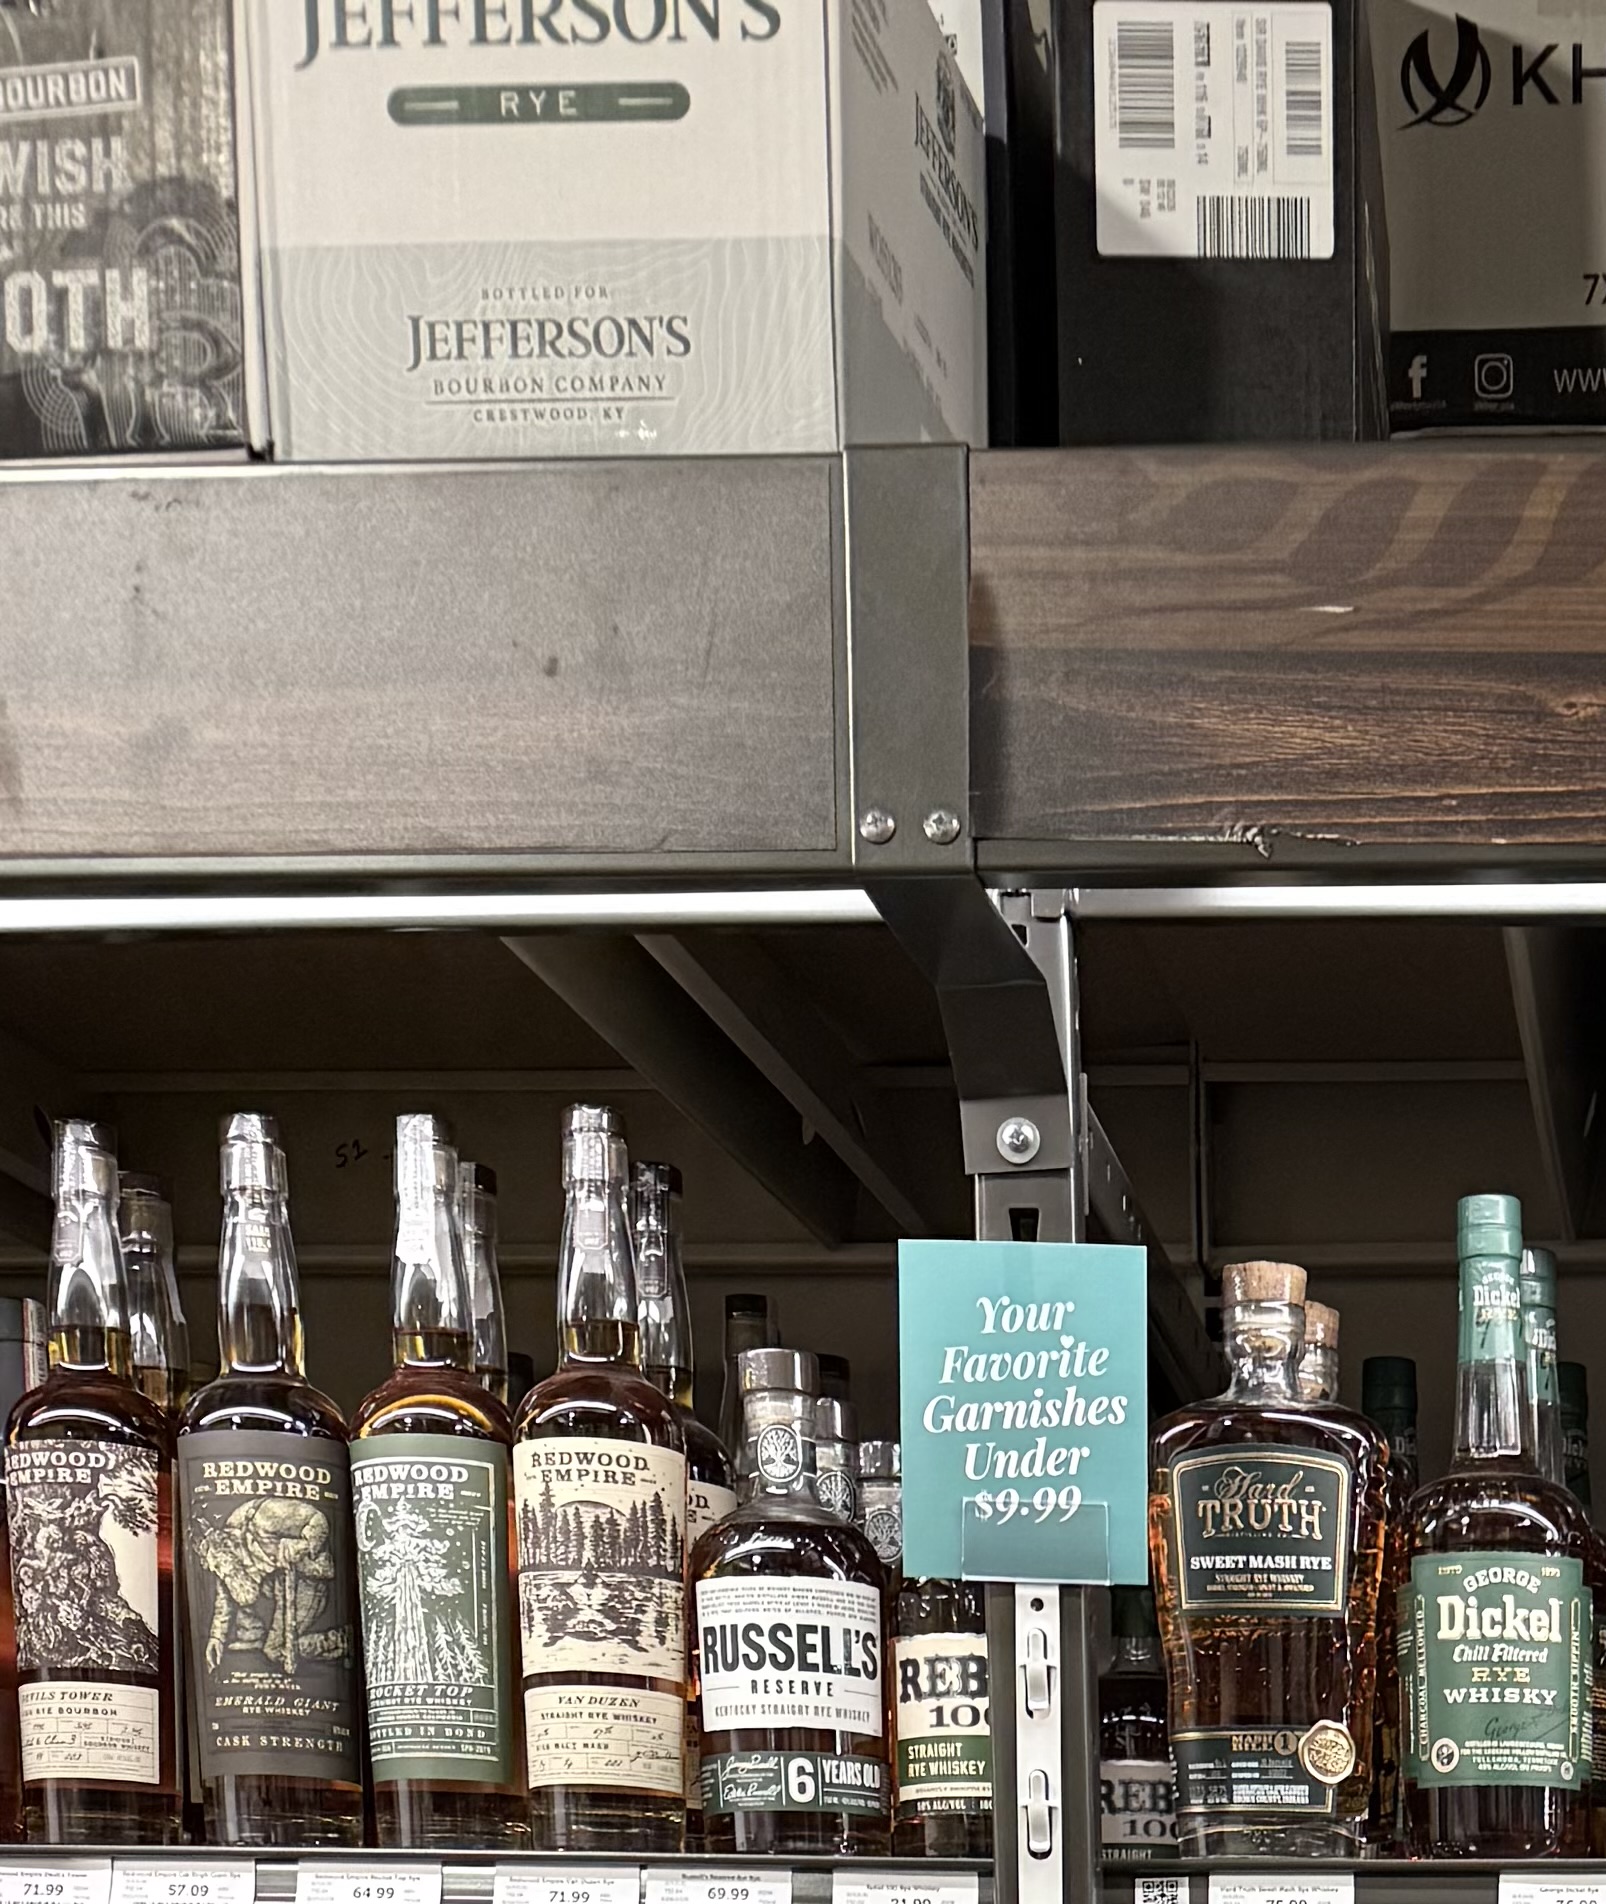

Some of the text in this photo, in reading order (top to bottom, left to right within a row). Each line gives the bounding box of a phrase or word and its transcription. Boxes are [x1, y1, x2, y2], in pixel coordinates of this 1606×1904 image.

[295, 0, 783, 70] JEFFERSON'S
[500, 88, 577, 118] RYE
[406, 314, 692, 372] JEFFERSON'S
[433, 375, 668, 396] BOURBON COMPANY
[976, 1297, 1074, 1335] Your
[940, 1336, 1109, 1383] Favorite
[922, 1386, 1128, 1433] Garnishes
[530, 1451, 650, 1472] REDWOOD
[540, 1467, 637, 1486] EMPIRE
[963, 1441, 1089, 1479] Under
[973, 1484, 1082, 1523] $9.99
[1198, 1498, 1327, 1541] TRUTH
[1190, 1555, 1332, 1570] SWEET MASH RYE
[1436, 1595, 1564, 1643] Dickel
[704, 1623, 879, 1679] RUSSELL'S
[751, 1679, 835, 1697] RESERVE
[1443, 1688, 1557, 1706] WHISKY
[23, 1883, 63, 1897] 71.99
